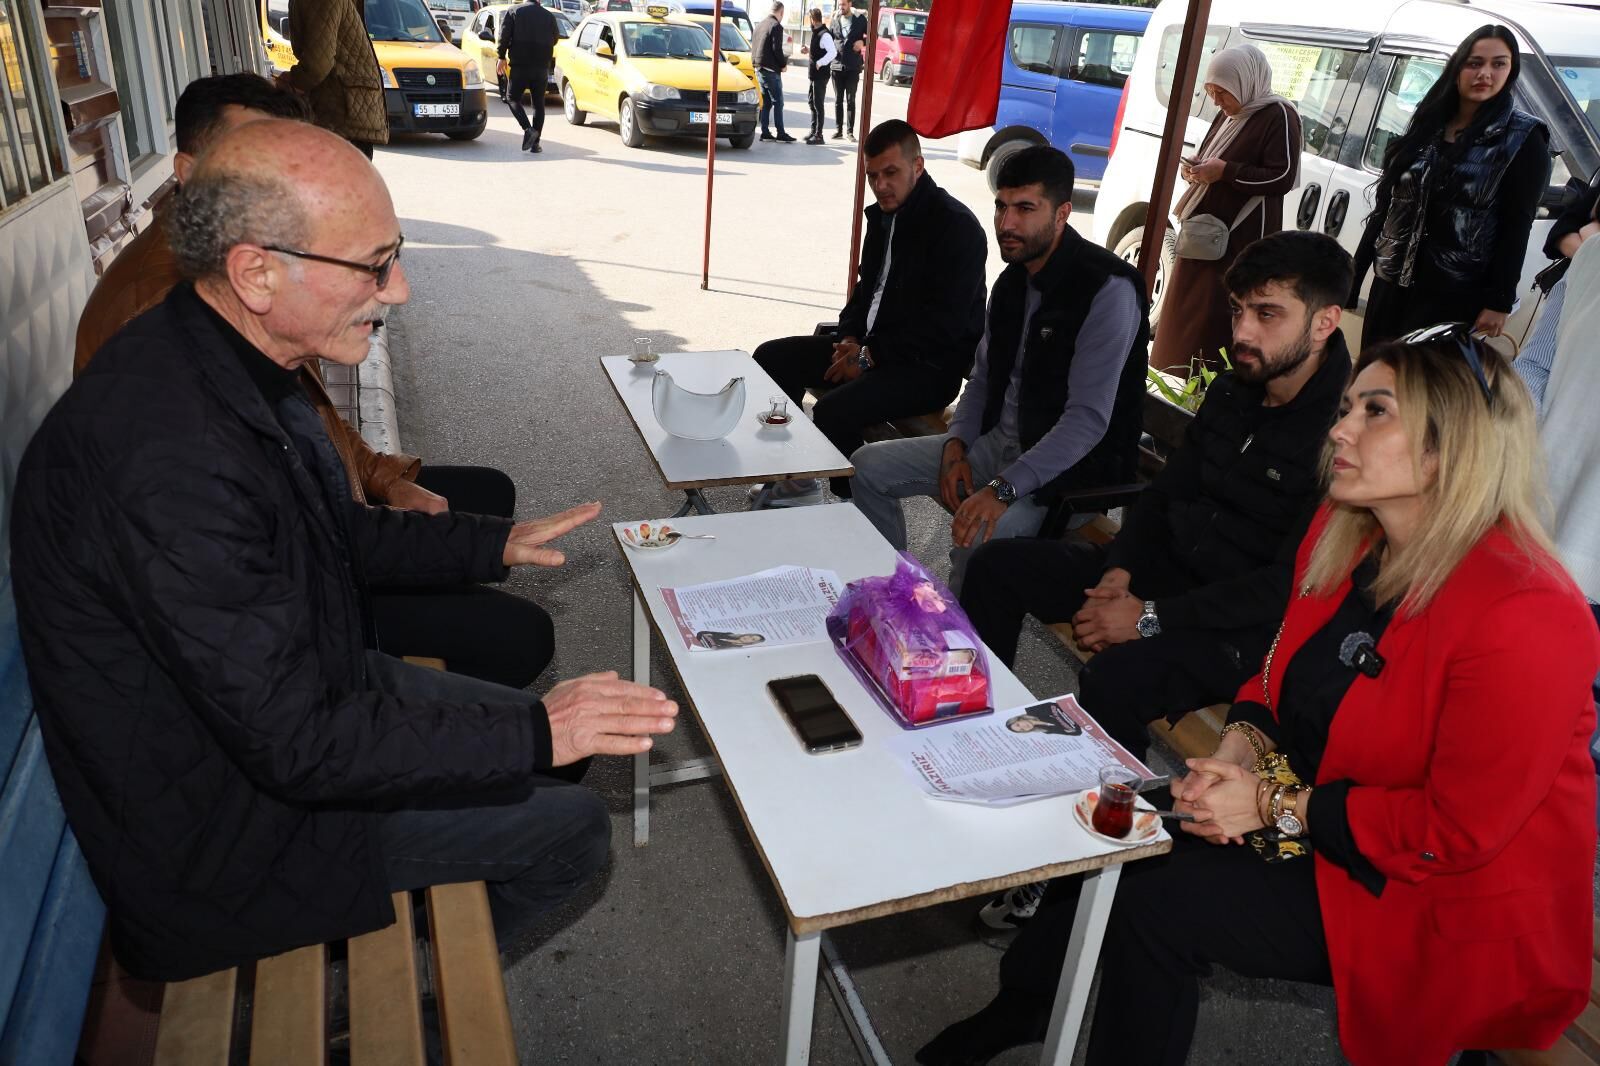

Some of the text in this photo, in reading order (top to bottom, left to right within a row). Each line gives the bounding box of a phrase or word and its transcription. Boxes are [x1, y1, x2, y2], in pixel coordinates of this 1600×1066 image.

[419, 105, 428, 114] 55
[442, 105, 459, 114] 4533
[694, 113, 704, 122] 55
